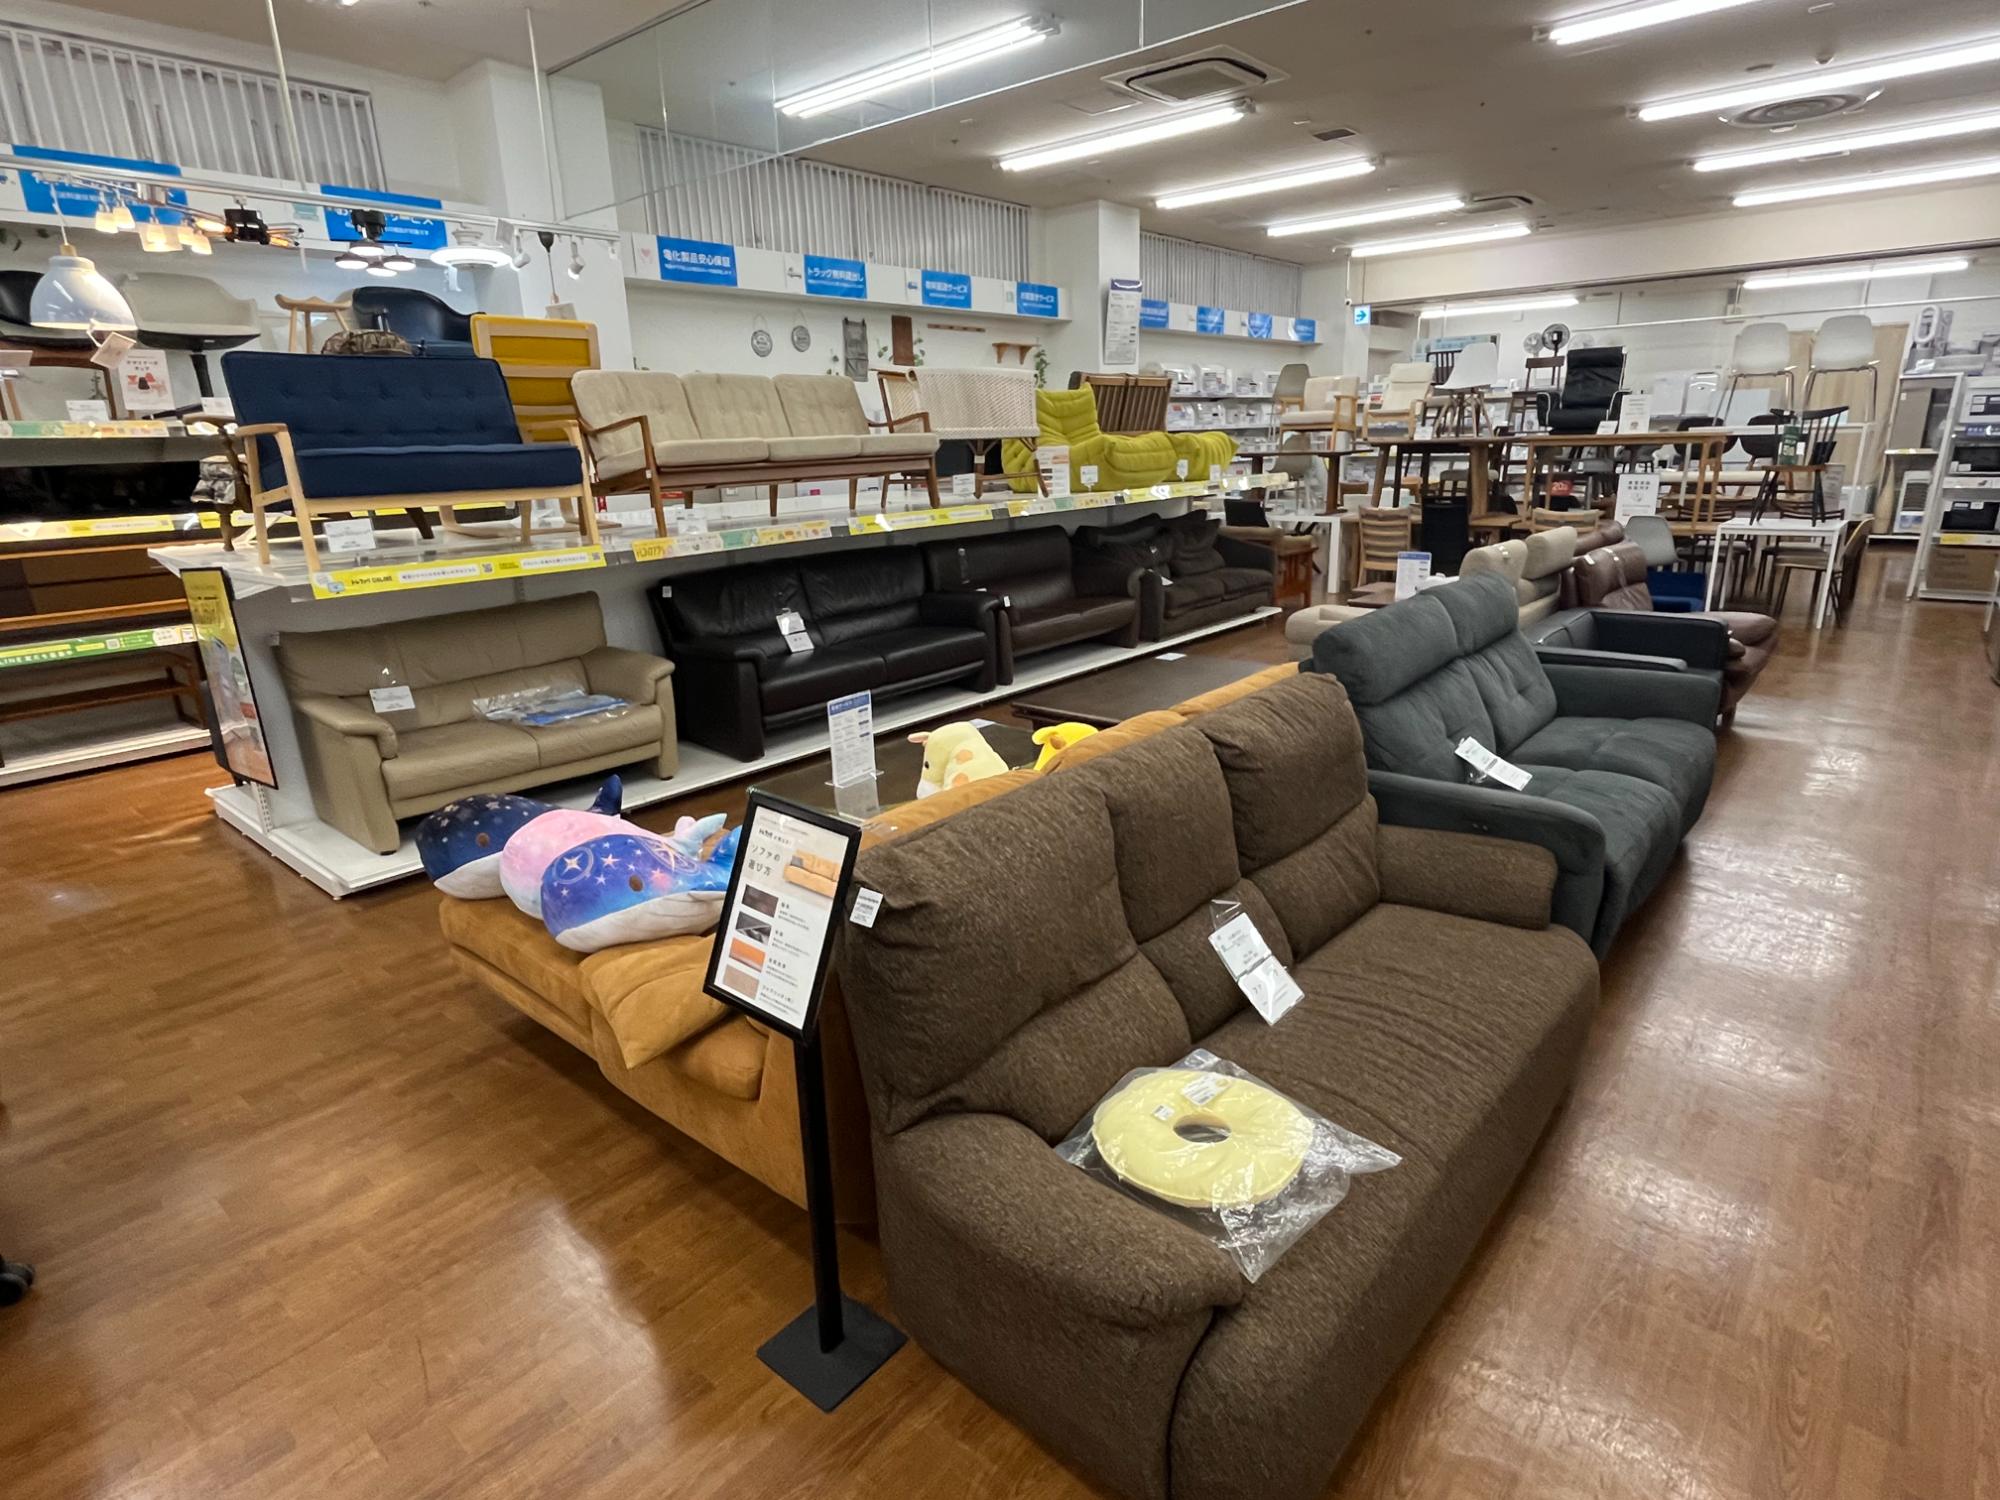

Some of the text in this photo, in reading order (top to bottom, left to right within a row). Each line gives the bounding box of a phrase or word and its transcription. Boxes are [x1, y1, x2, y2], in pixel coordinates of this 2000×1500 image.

[751, 843, 782, 861] ソファの
[747, 858, 774, 877] 選び方
